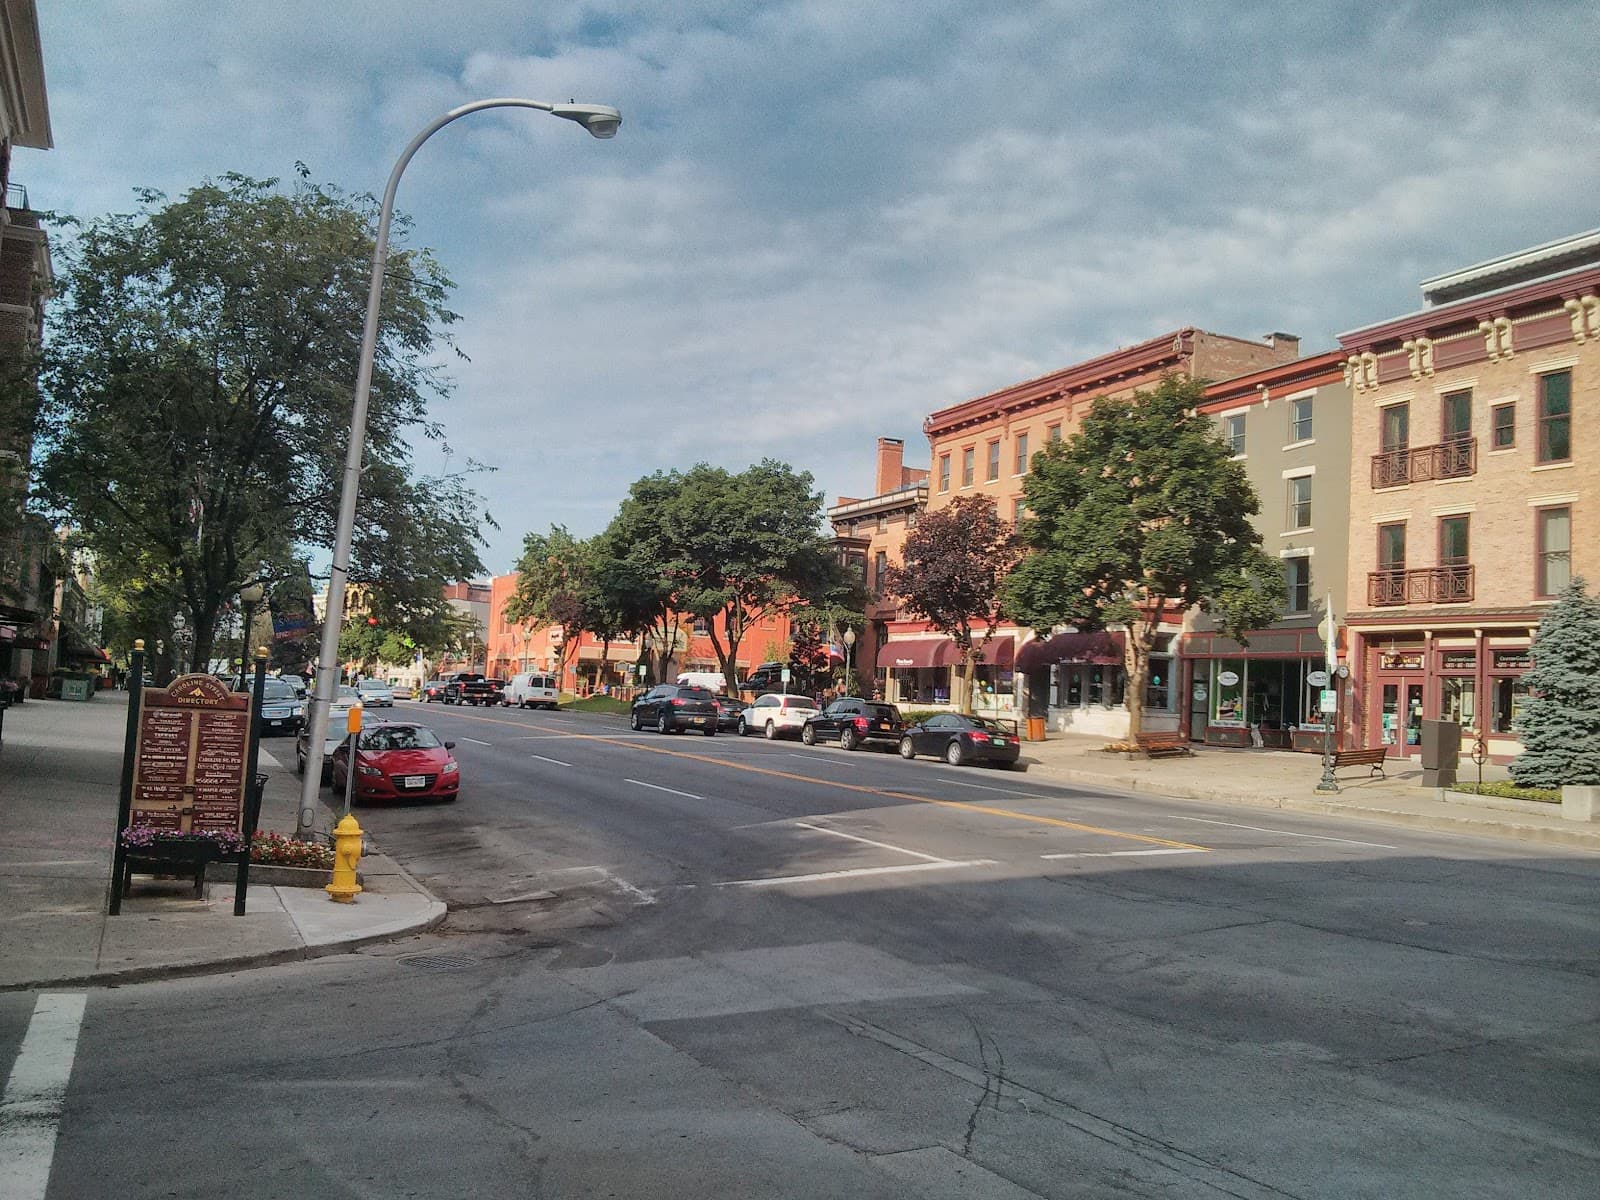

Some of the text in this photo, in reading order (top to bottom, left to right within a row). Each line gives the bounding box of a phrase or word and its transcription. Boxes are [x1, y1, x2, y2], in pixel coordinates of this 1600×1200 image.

[171, 679, 226, 701] CAROLINE STREET
[177, 696, 219, 705] DIRECTORY
